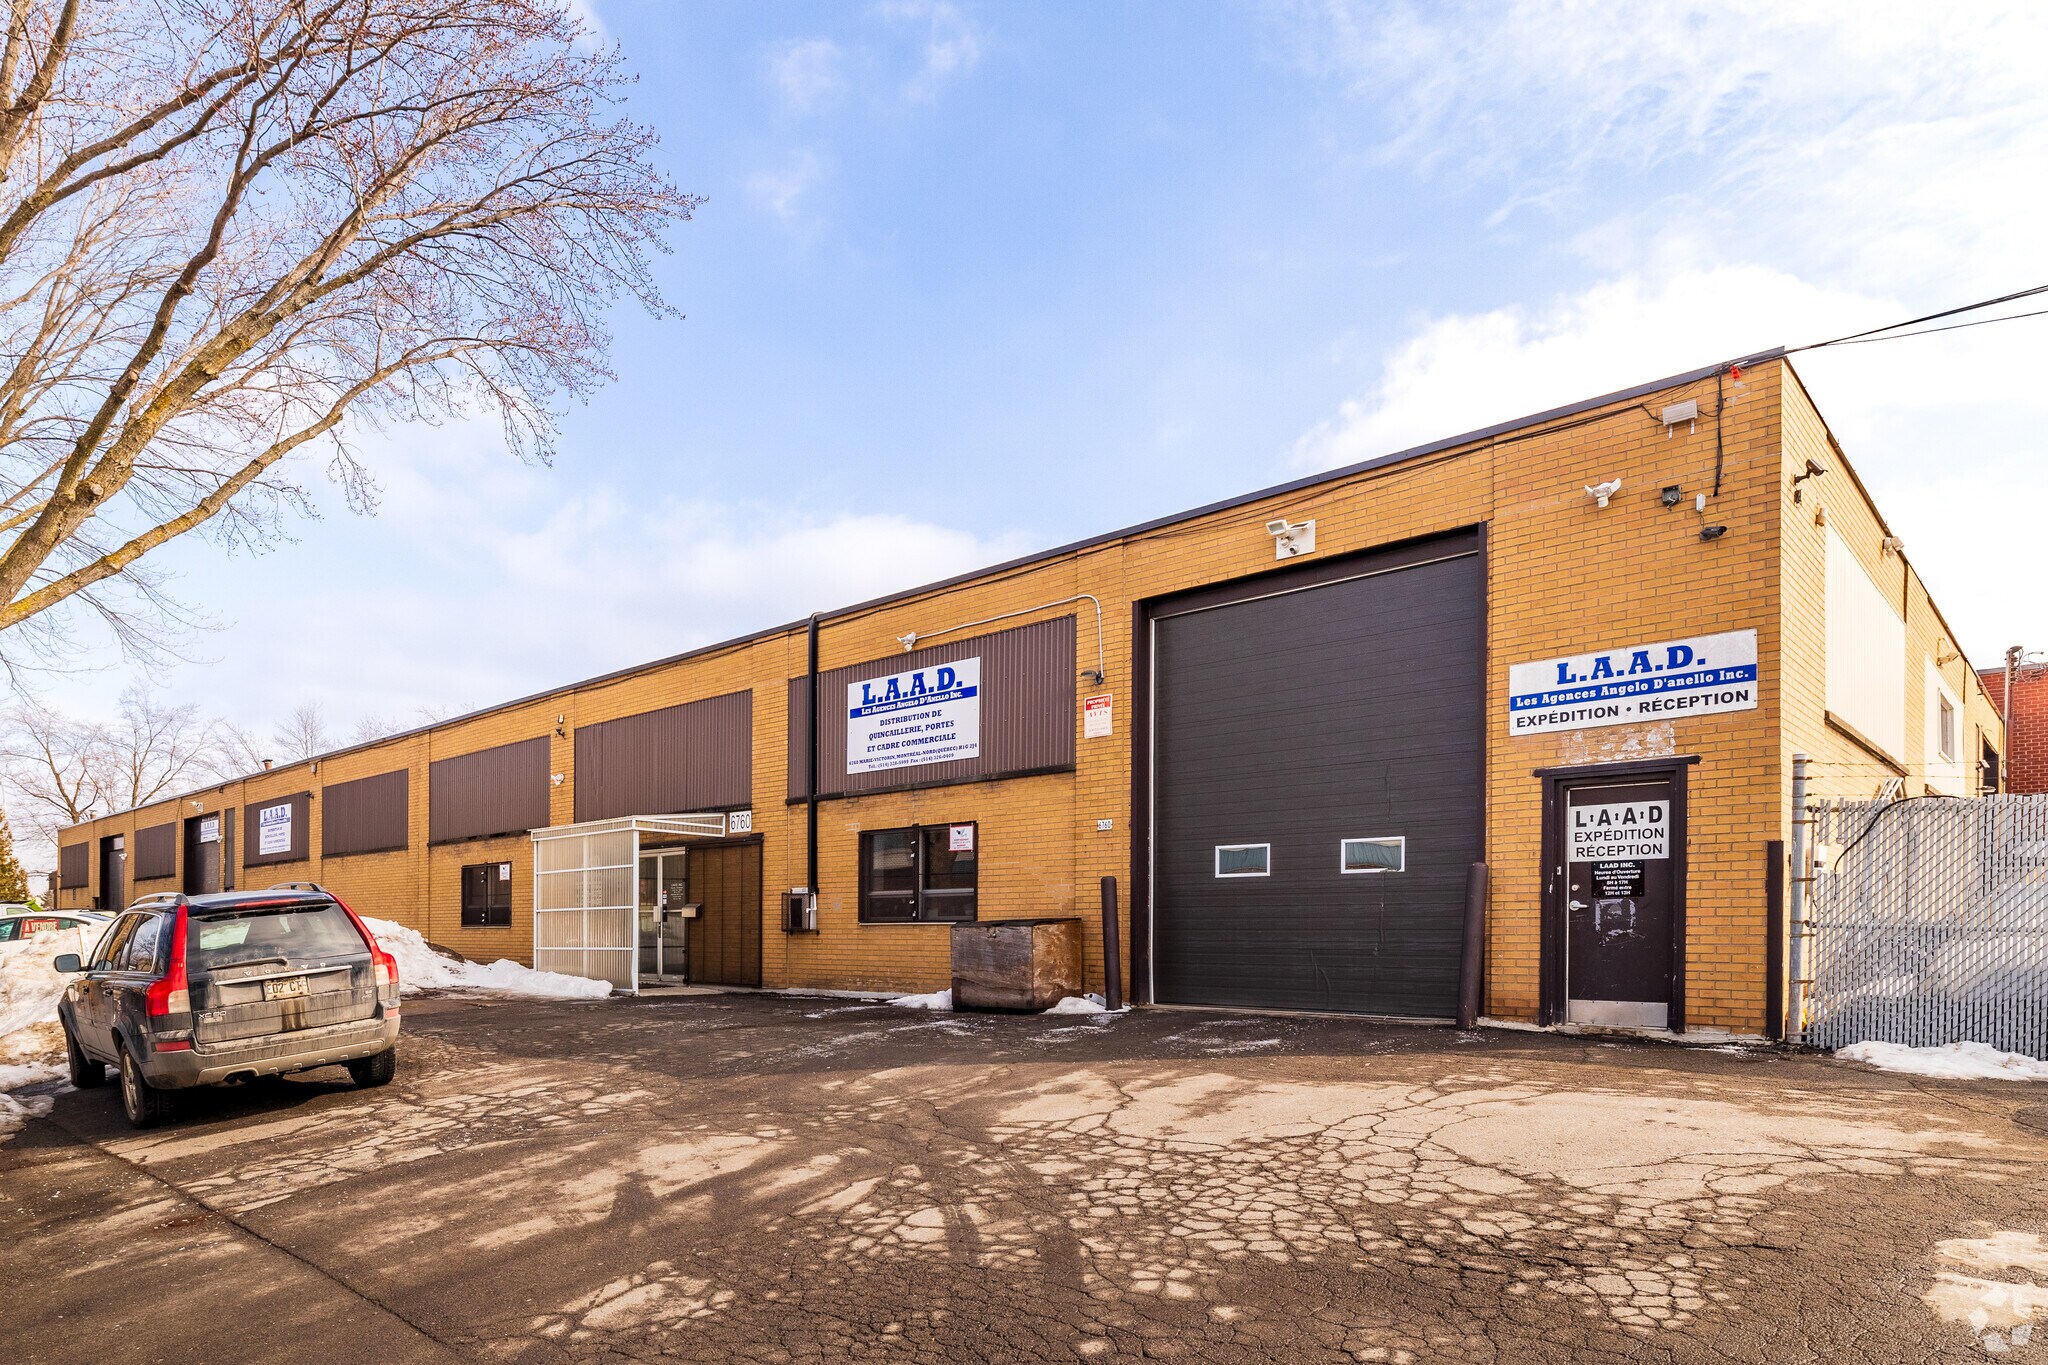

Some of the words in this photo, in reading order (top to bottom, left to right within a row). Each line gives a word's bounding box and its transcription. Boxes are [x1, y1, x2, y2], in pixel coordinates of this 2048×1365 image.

[1556, 644, 1706, 685] L.A.A.D.
[862, 667, 963, 706] L.A.A.D.
[1516, 697, 1538, 708] Les
[1541, 689, 1597, 705] Agences
[1601, 682, 1649, 698] Angelo
[1653, 673, 1714, 690] D'anello
[1719, 668, 1749, 681] Inc.
[879, 711, 931, 727] DISTRIBUTION
[931, 709, 942, 718] DE
[1516, 705, 1619, 728] EXPÉDITION
[1639, 689, 1749, 713] RÉCEPTION
[868, 725, 924, 741] QUINCAILLERIE,
[925, 720, 955, 731] PORTES
[867, 744, 876, 753] ET
[876, 741, 900, 752] CADRE
[901, 732, 957, 748] COMMERCIALE
[731, 814, 750, 830] 6760
[1574, 827, 1664, 843] EXPÉDITION
[1576, 843, 1663, 858] RÉCEPTION
[31, 921, 58, 931] VENDRE
